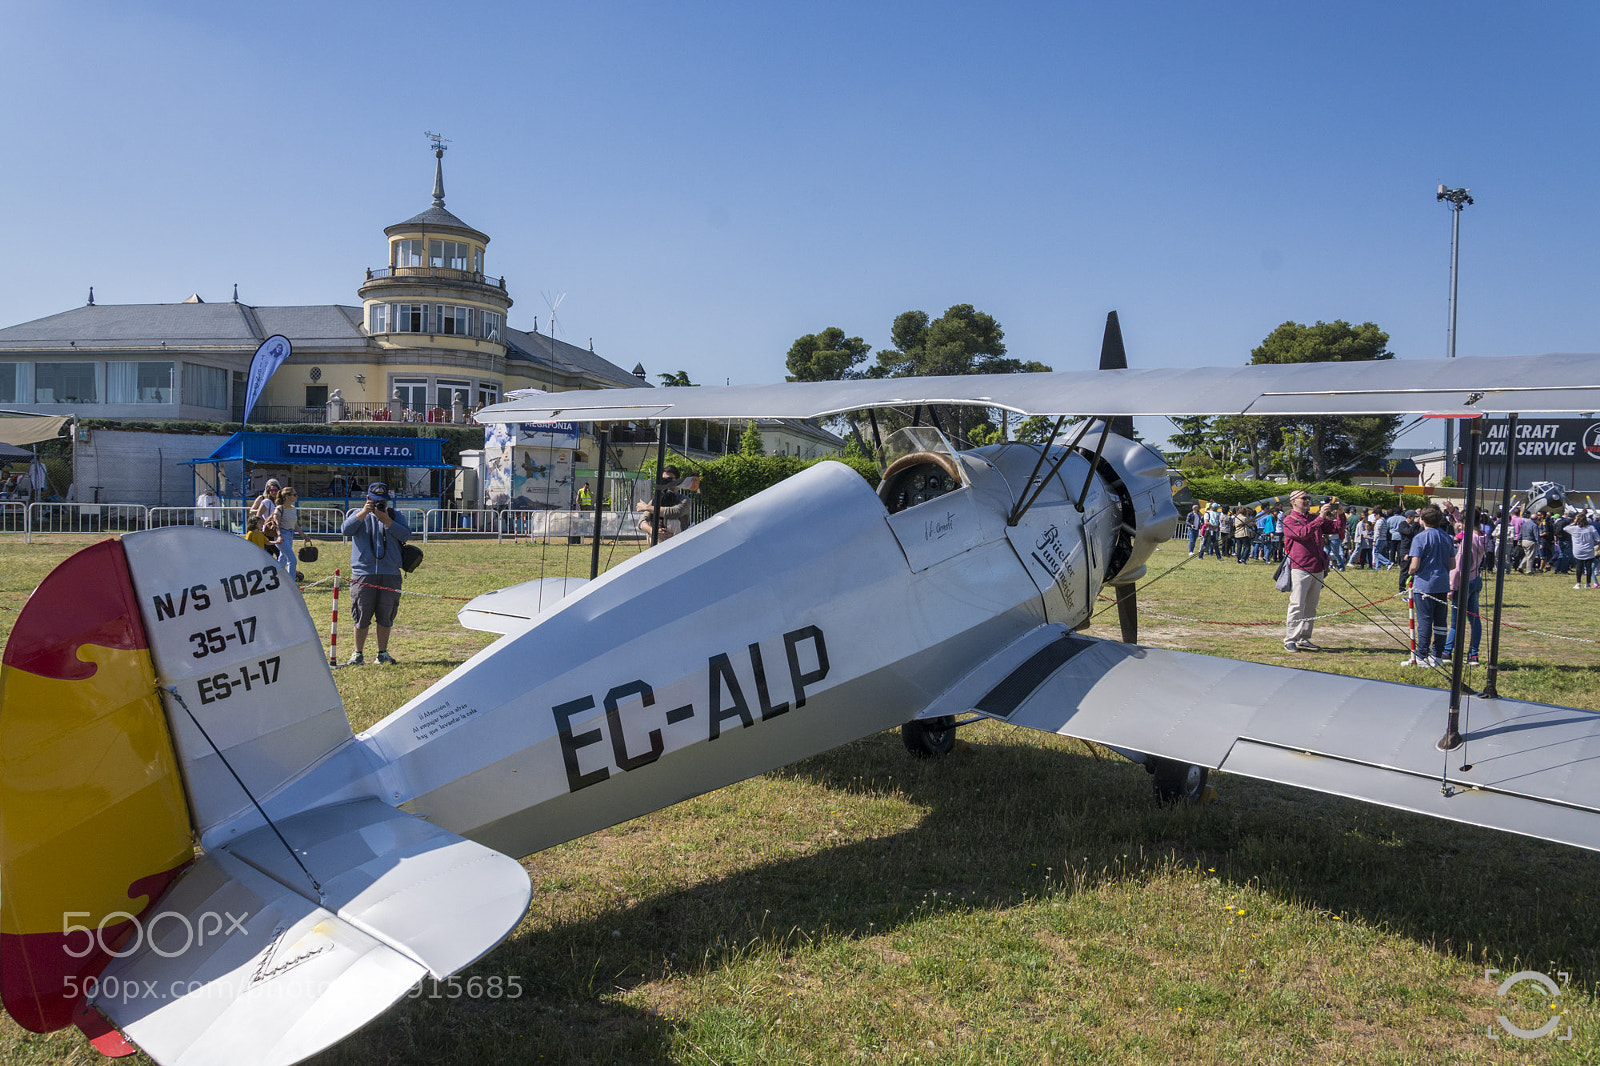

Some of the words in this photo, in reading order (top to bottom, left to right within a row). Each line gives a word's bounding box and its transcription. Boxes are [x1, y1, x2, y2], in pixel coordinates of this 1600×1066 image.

[288, 444, 332, 454] TIENDA
[335, 445, 381, 455] OFICIAL
[384, 446, 412, 456] F.I.O.
[1517, 441, 1577, 456] SERVICE
[594, 470, 626, 478] SLIDA
[152, 583, 211, 622] N/S
[220, 565, 280, 603] 1023
[189, 616, 257, 659] 35-17
[197, 656, 281, 705] ES-1-17
[551, 624, 830, 793] EC-ALP
